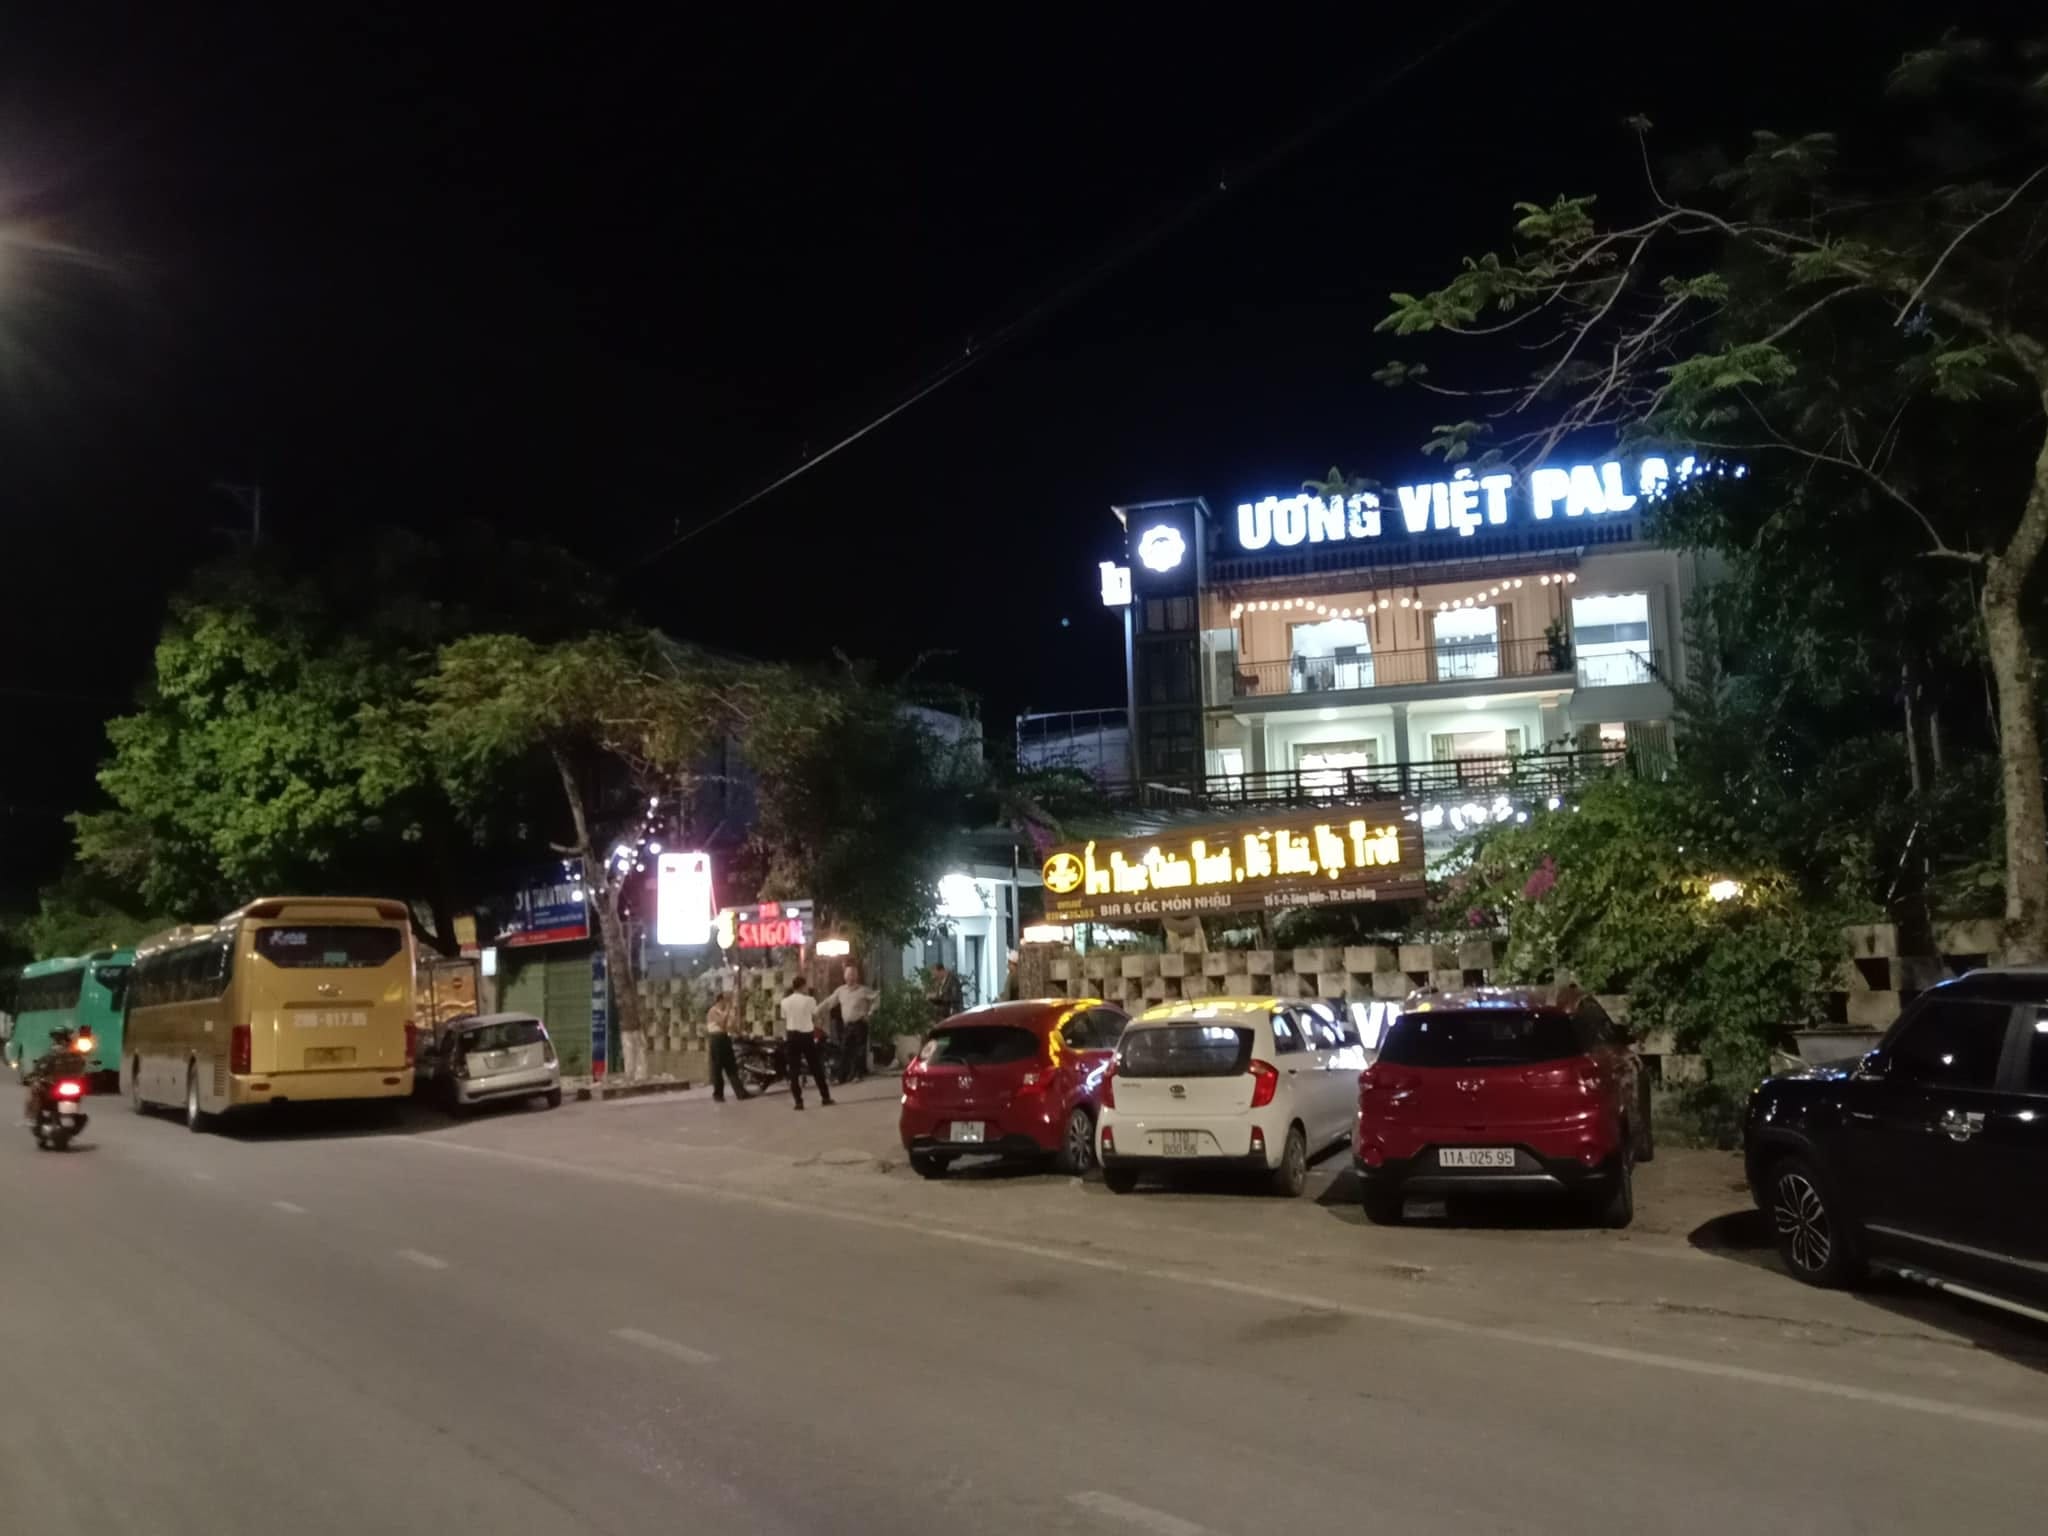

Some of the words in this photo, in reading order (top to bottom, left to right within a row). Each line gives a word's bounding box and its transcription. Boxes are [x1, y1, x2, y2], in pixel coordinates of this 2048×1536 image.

[1398, 467, 1514, 537] VIỆT
[1100, 904, 1121, 916] BIA
[1134, 897, 1159, 913] CÁC
[1161, 894, 1192, 912] MÓN
